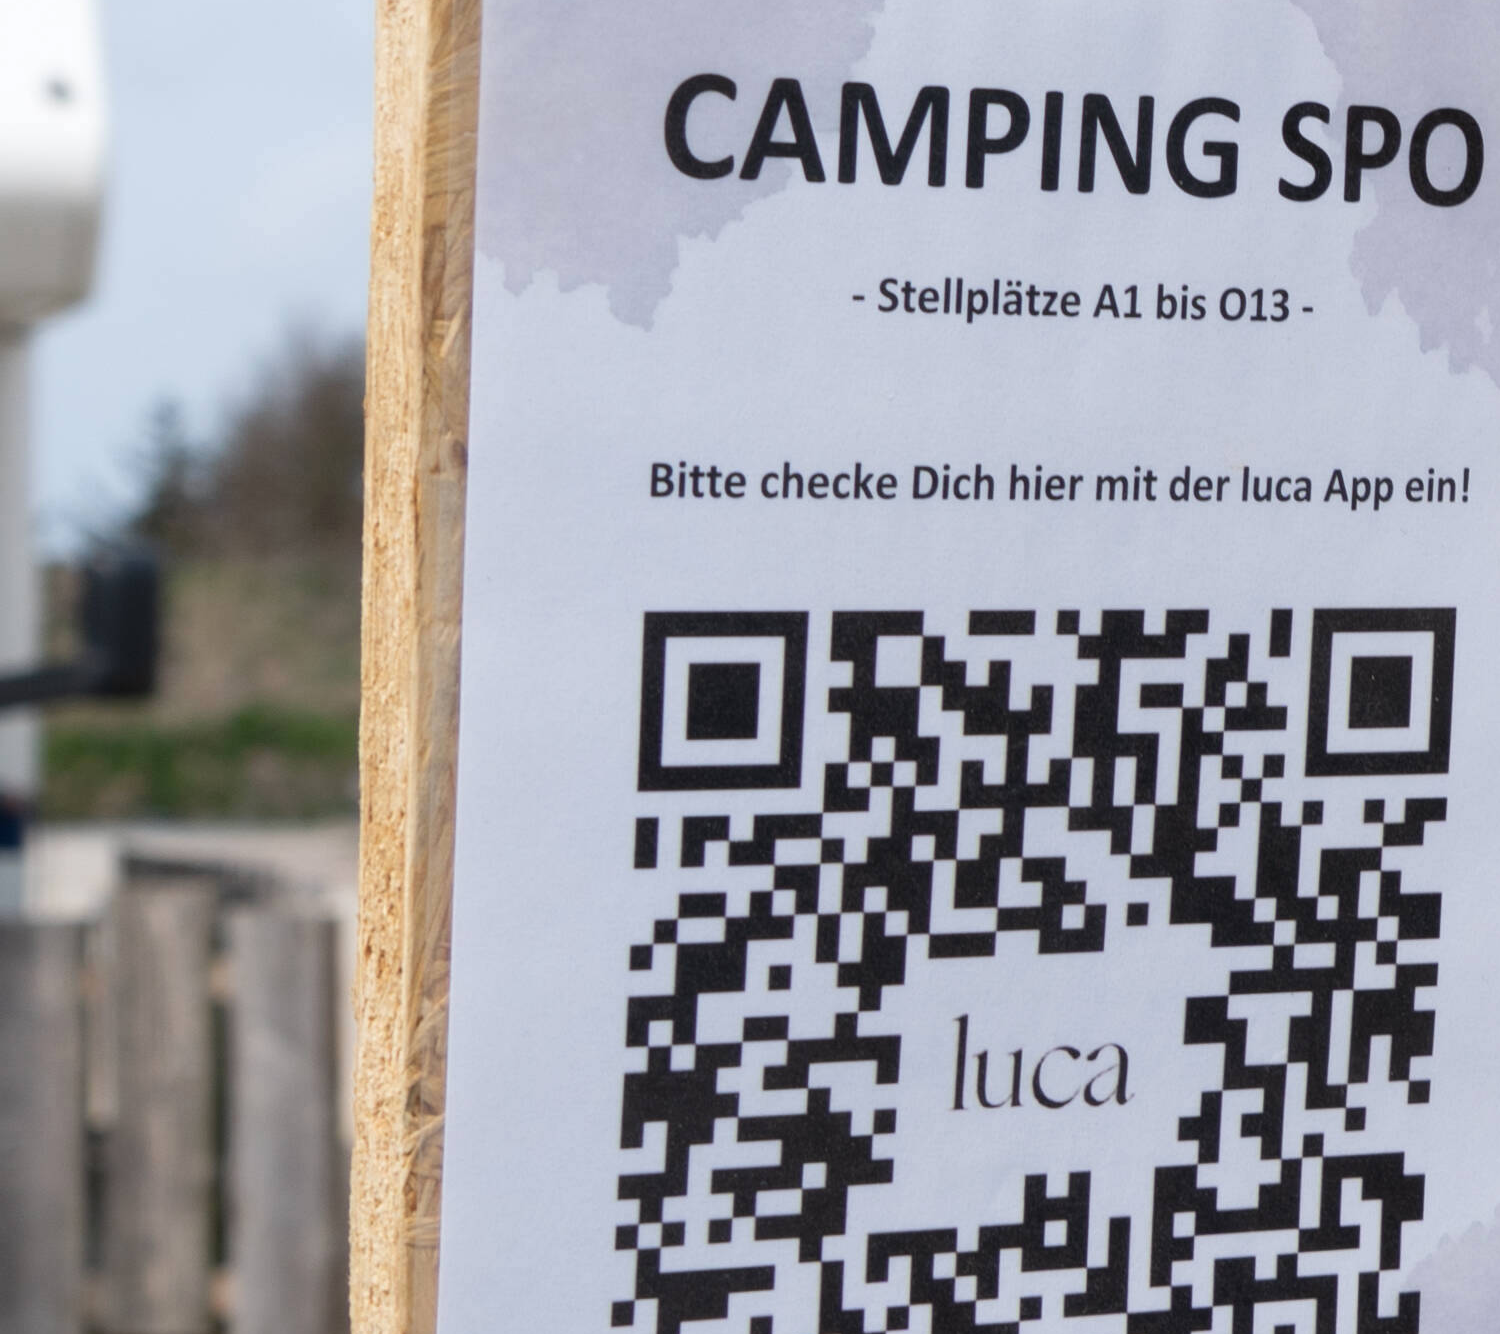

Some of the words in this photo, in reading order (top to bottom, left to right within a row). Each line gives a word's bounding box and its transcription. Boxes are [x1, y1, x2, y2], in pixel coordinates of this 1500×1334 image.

[662, 71, 1242, 200] CAMPING
[1277, 100, 1486, 209] SPO
[876, 276, 1082, 325] Stellplätze
[1091, 282, 1144, 320] A1
[1155, 282, 1208, 322] bis
[649, 459, 748, 500] Bitte
[759, 460, 899, 501] checke
[911, 462, 996, 502] Dich
[1008, 462, 1085, 503] hier
[1094, 464, 1159, 503] mit
[1168, 464, 1232, 503] der
[1240, 464, 1313, 504] luca
[1322, 467, 1395, 513] App
[1404, 466, 1471, 504] ein!
[951, 1013, 1135, 1111] luca
